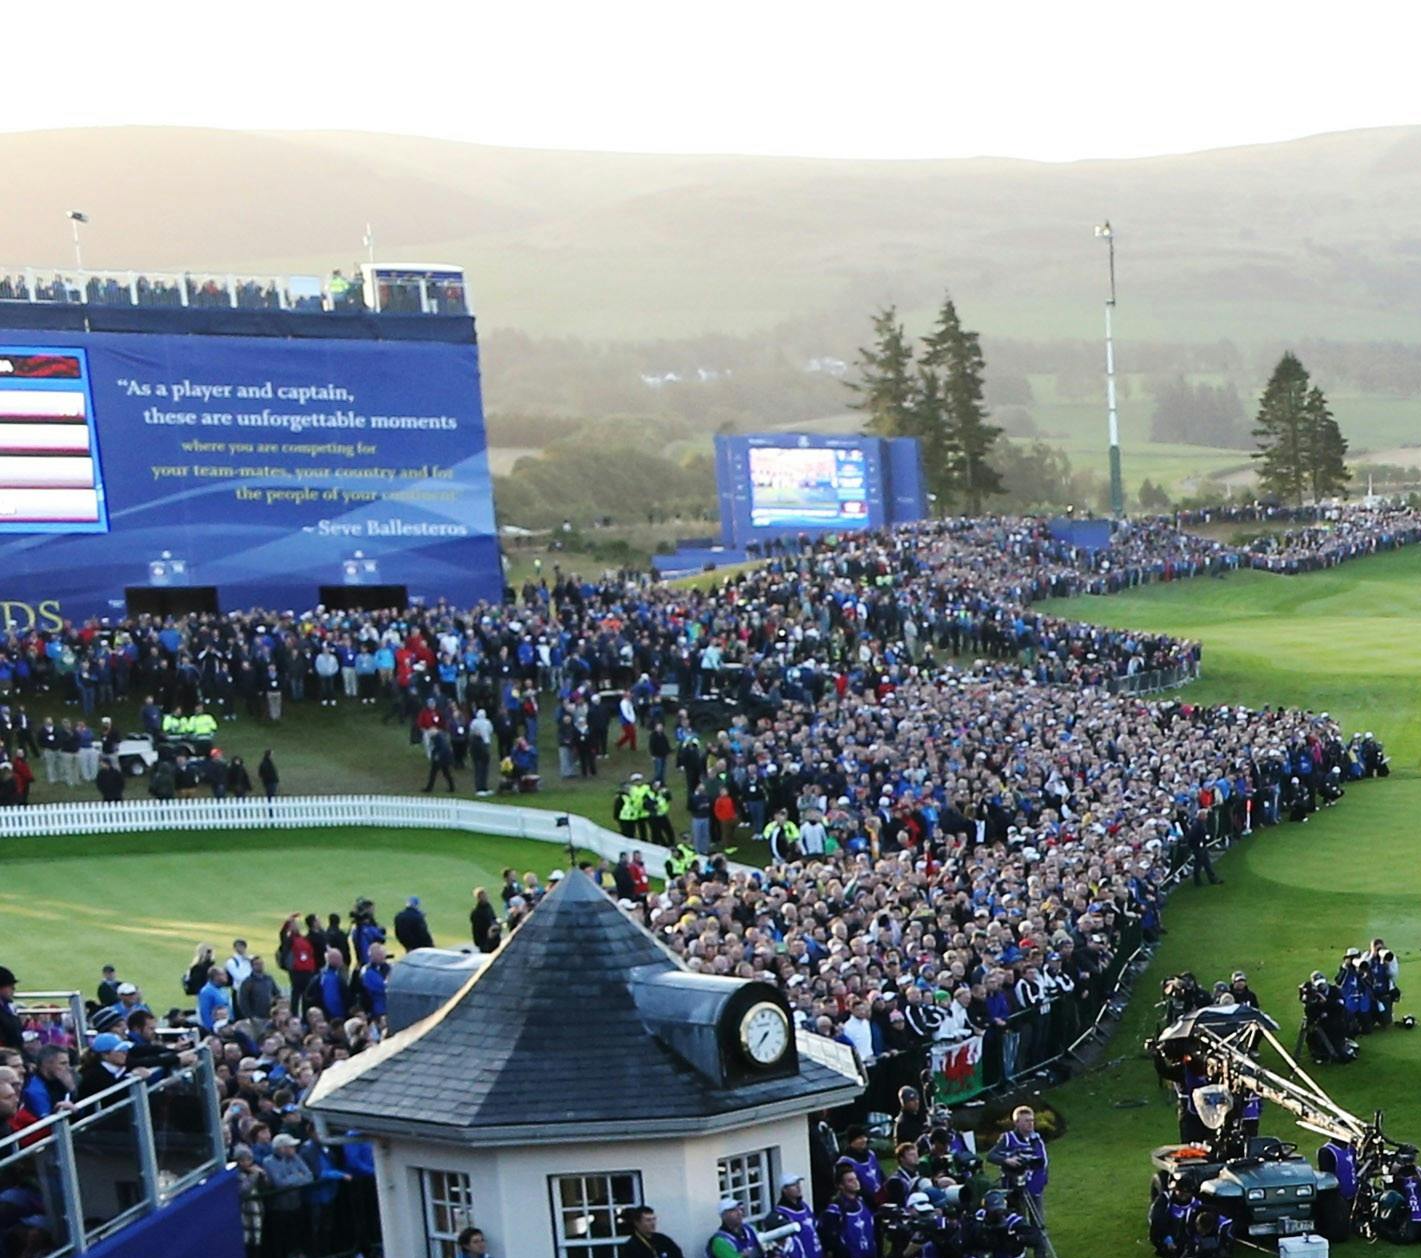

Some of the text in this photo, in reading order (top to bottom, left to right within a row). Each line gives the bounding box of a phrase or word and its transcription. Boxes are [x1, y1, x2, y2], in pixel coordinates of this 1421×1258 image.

[156, 385, 168, 396] a
[172, 380, 232, 402] player
[237, 381, 273, 399] and
[277, 383, 354, 404] captain,
[144, 407, 457, 433] these are unforgettable moments
[182, 438, 376, 458] where you are competing for
[151, 465, 189, 480] your
[295, 466, 331, 481] your
[335, 466, 396, 482] country
[401, 464, 428, 479] and
[236, 485, 262, 500] the
[266, 485, 318, 505] people
[322, 486, 338, 500] of
[344, 490, 377, 504] your
[318, 518, 362, 537] Seve
[367, 518, 467, 537] Ballesteros
